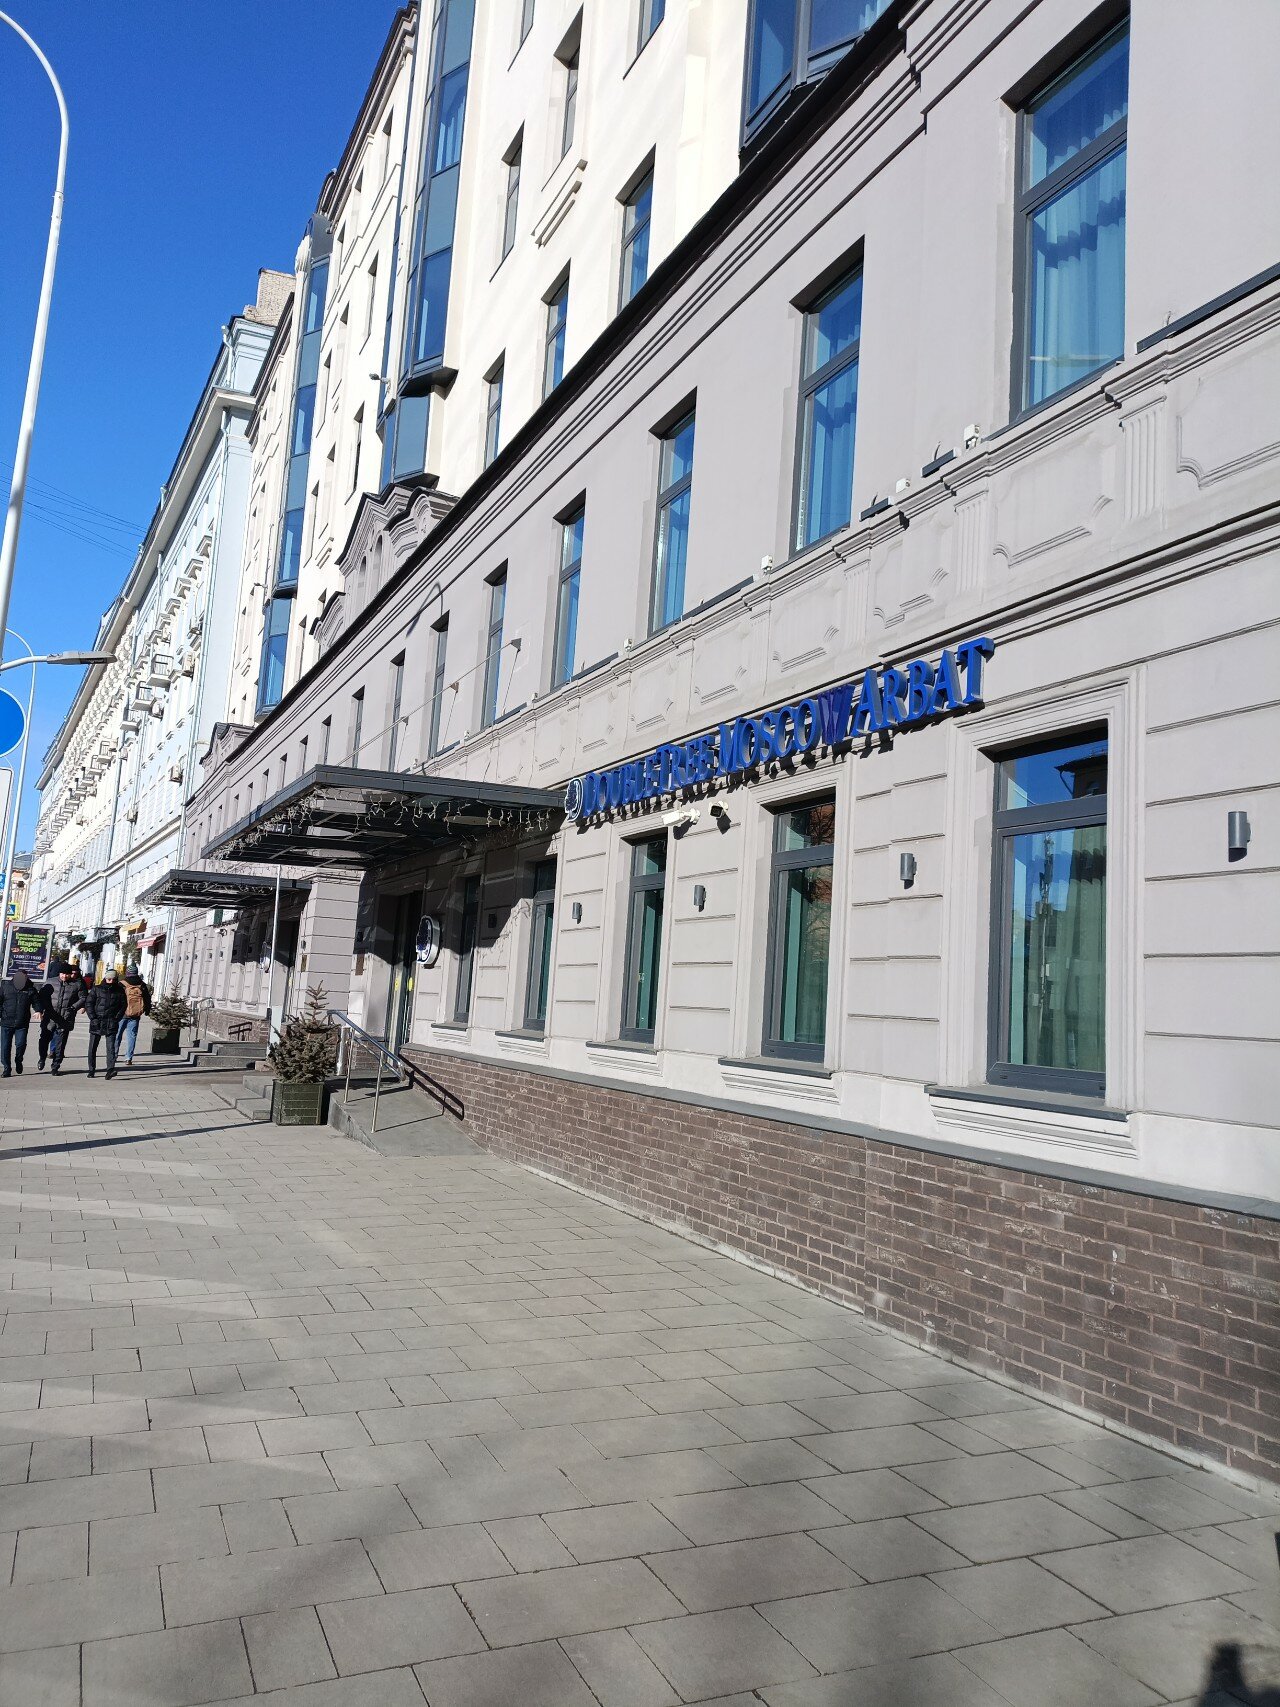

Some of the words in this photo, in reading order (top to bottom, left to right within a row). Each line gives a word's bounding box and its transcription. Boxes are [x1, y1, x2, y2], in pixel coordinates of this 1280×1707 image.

[583, 735, 715, 817] DOUBLETREE
[715, 684, 855, 777] MOSCOW
[851, 636, 995, 737] ARBAT
